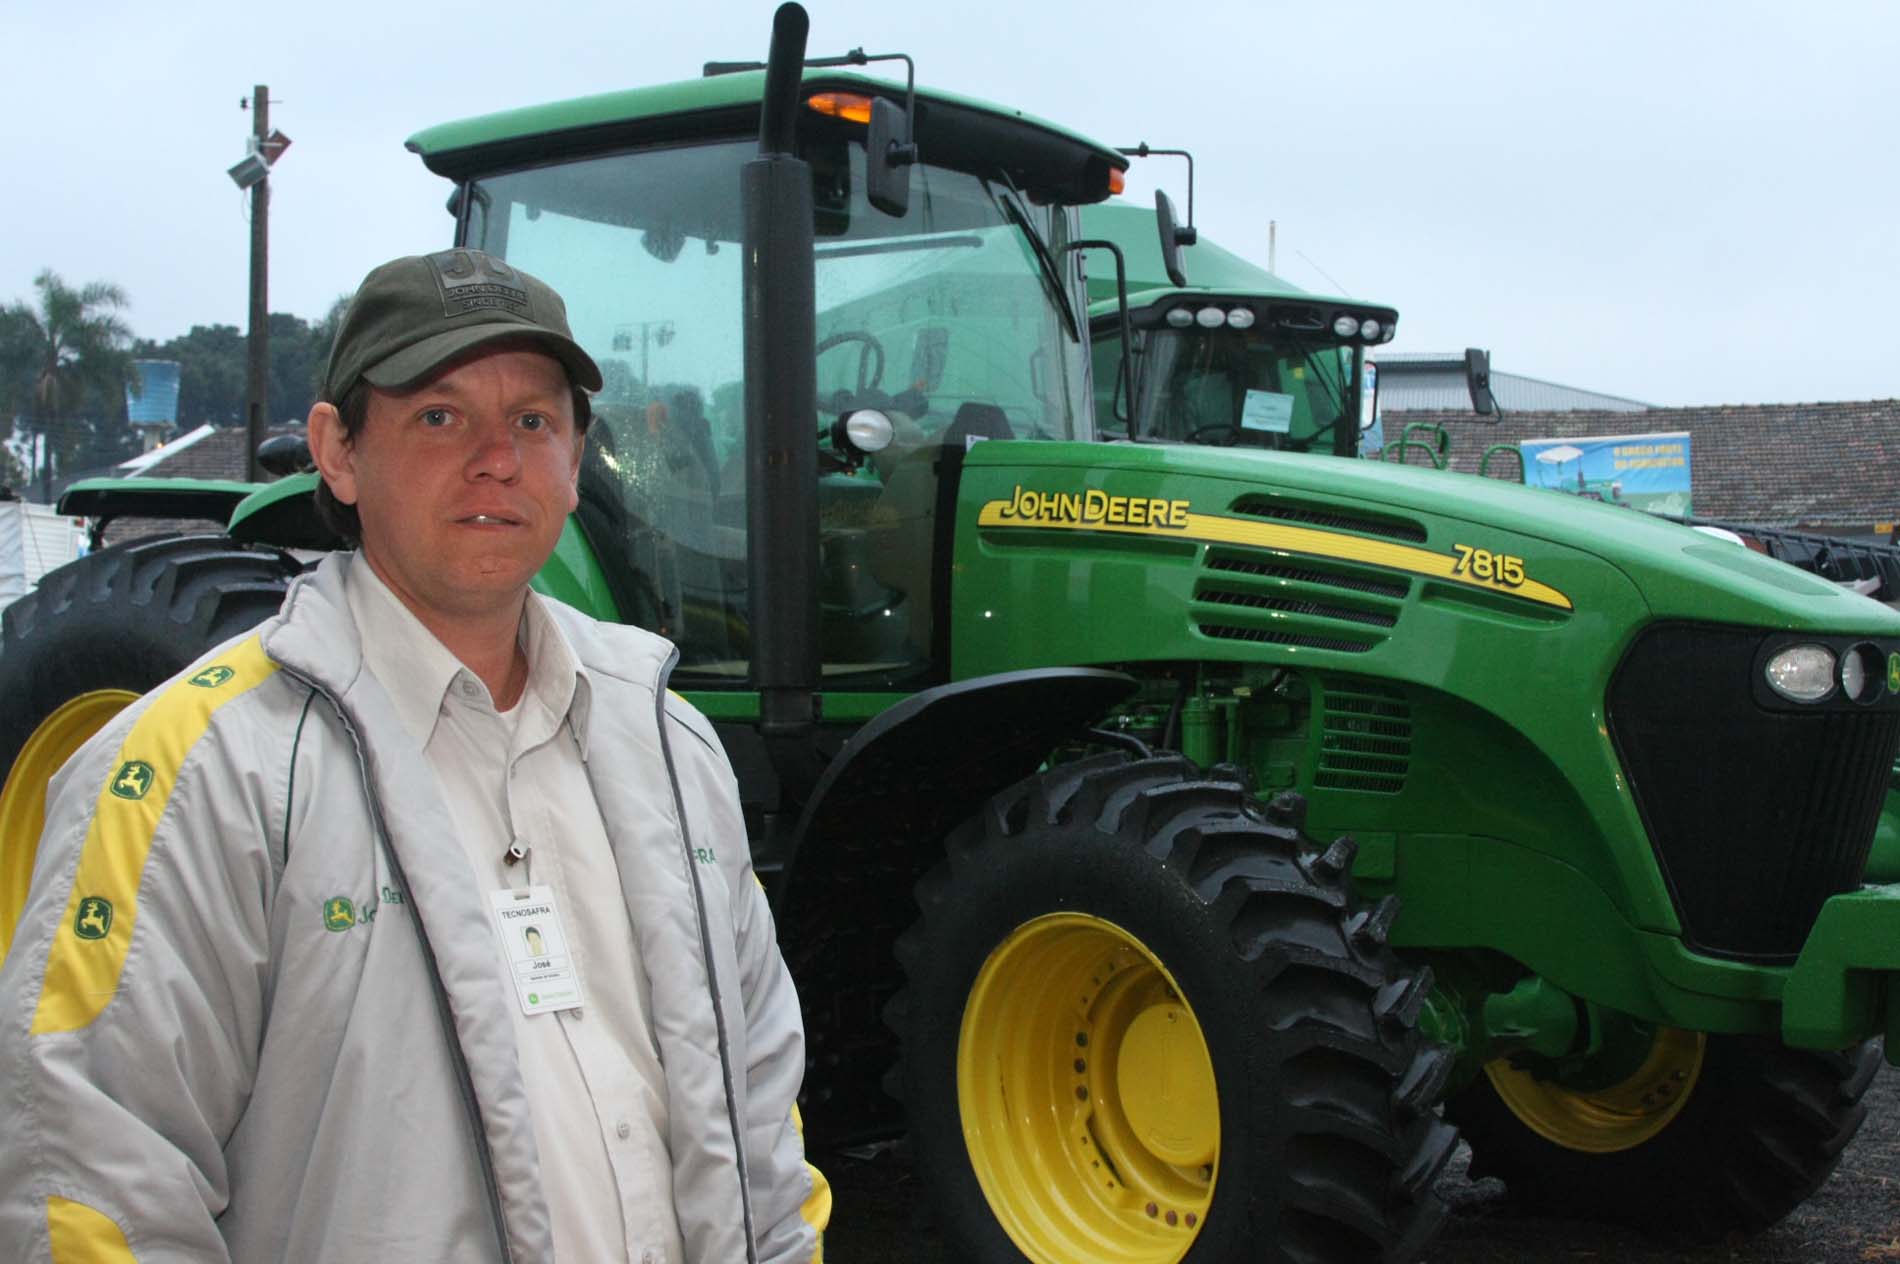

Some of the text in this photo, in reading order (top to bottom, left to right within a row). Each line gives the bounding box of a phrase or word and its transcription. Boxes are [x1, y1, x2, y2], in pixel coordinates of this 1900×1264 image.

[1001, 485, 1190, 528] JOHN DEERE
[1453, 543, 1526, 587] 7815
[501, 906, 551, 919] TECNOSAFRA
